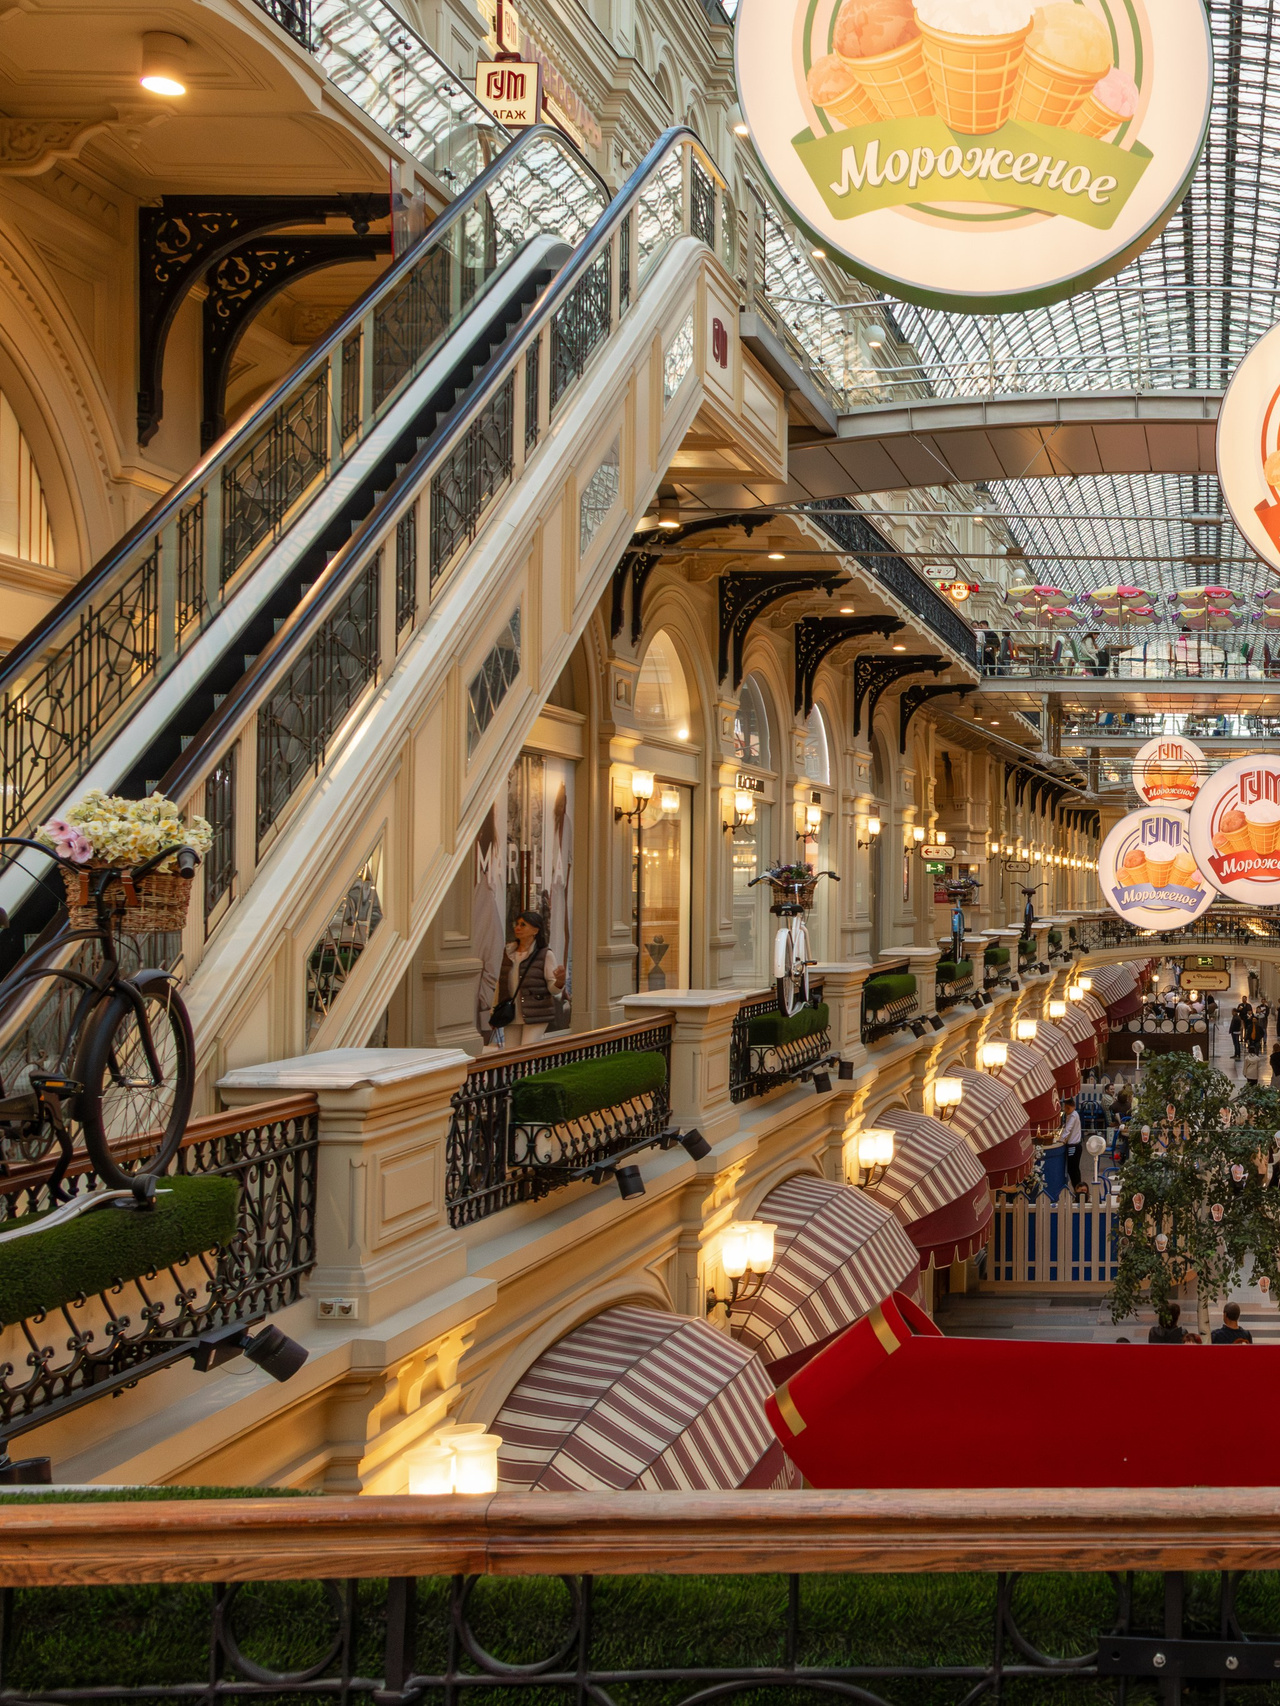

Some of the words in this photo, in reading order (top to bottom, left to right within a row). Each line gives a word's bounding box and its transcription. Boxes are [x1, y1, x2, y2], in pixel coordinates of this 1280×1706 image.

[486, 69, 527, 101] ГУМ
[491, 109, 527, 120] АГАЖ
[829, 138, 1119, 205] Мороженое
[1158, 742, 1183, 761] ГУМ
[1147, 785, 1196, 800] Мороженое
[1141, 817, 1182, 848] ГУМ
[1120, 888, 1198, 907] Мороженое
